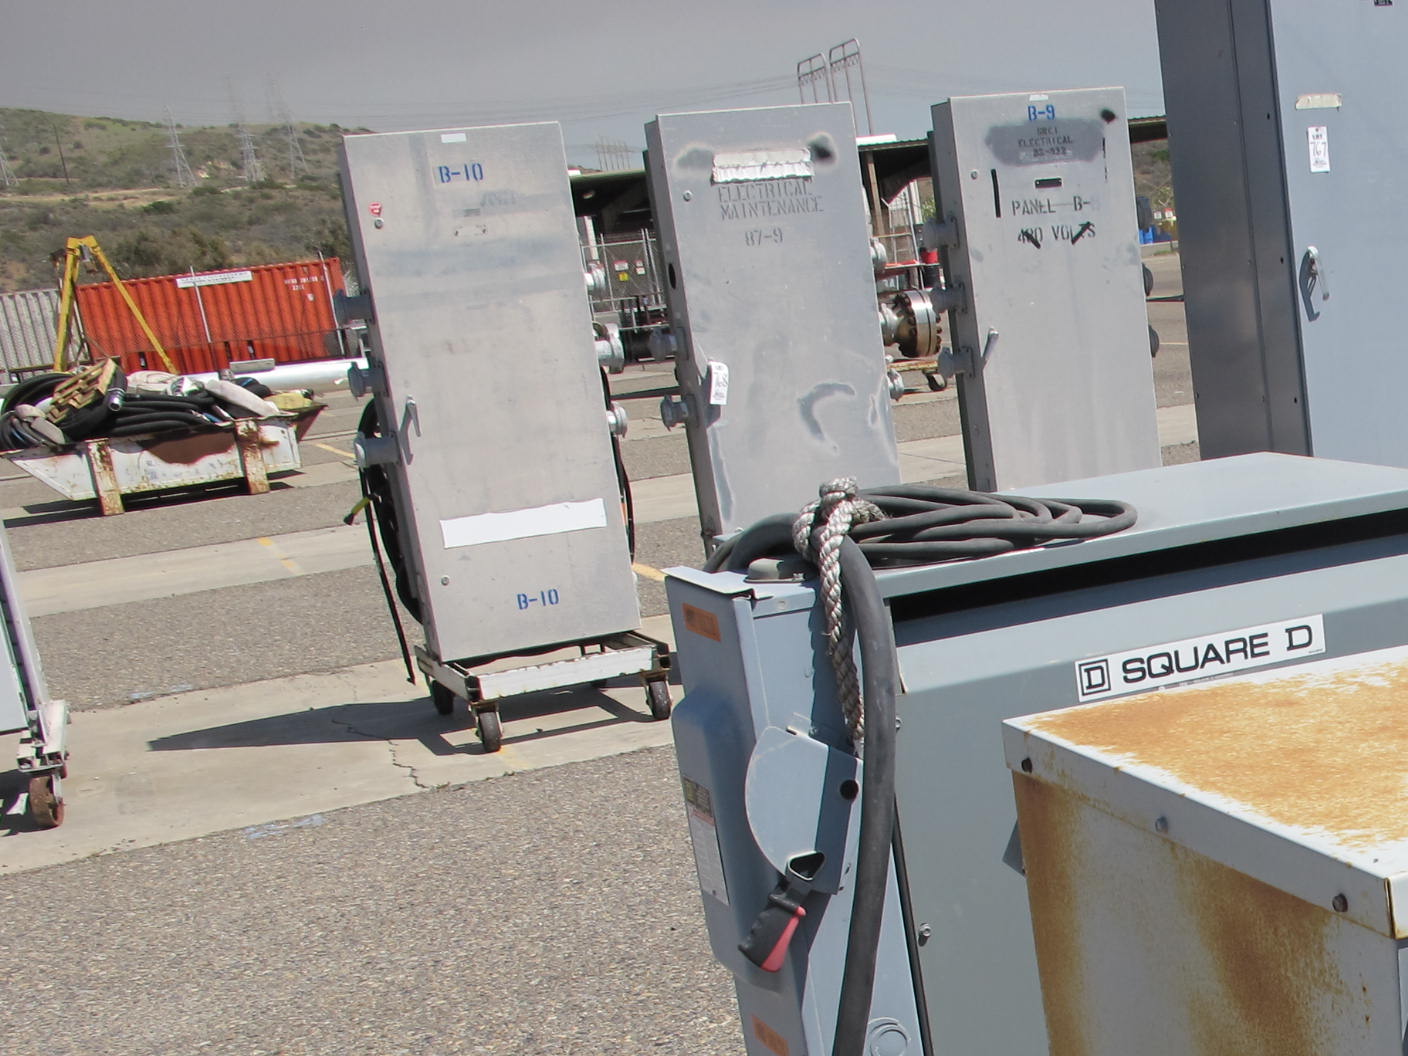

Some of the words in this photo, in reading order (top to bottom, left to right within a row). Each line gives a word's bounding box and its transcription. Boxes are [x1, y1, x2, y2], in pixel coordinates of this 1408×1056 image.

[1027, 104, 1055, 121] B-9
[438, 162, 484, 183] B-10
[718, 181, 813, 203] ELECTRICAL
[720, 196, 824, 220] MAINTENANCE
[1012, 198, 1056, 216] PANEL
[517, 589, 559, 610] B-10
[1121, 632, 1270, 684] SQUARE
[1285, 624, 1313, 651] D
